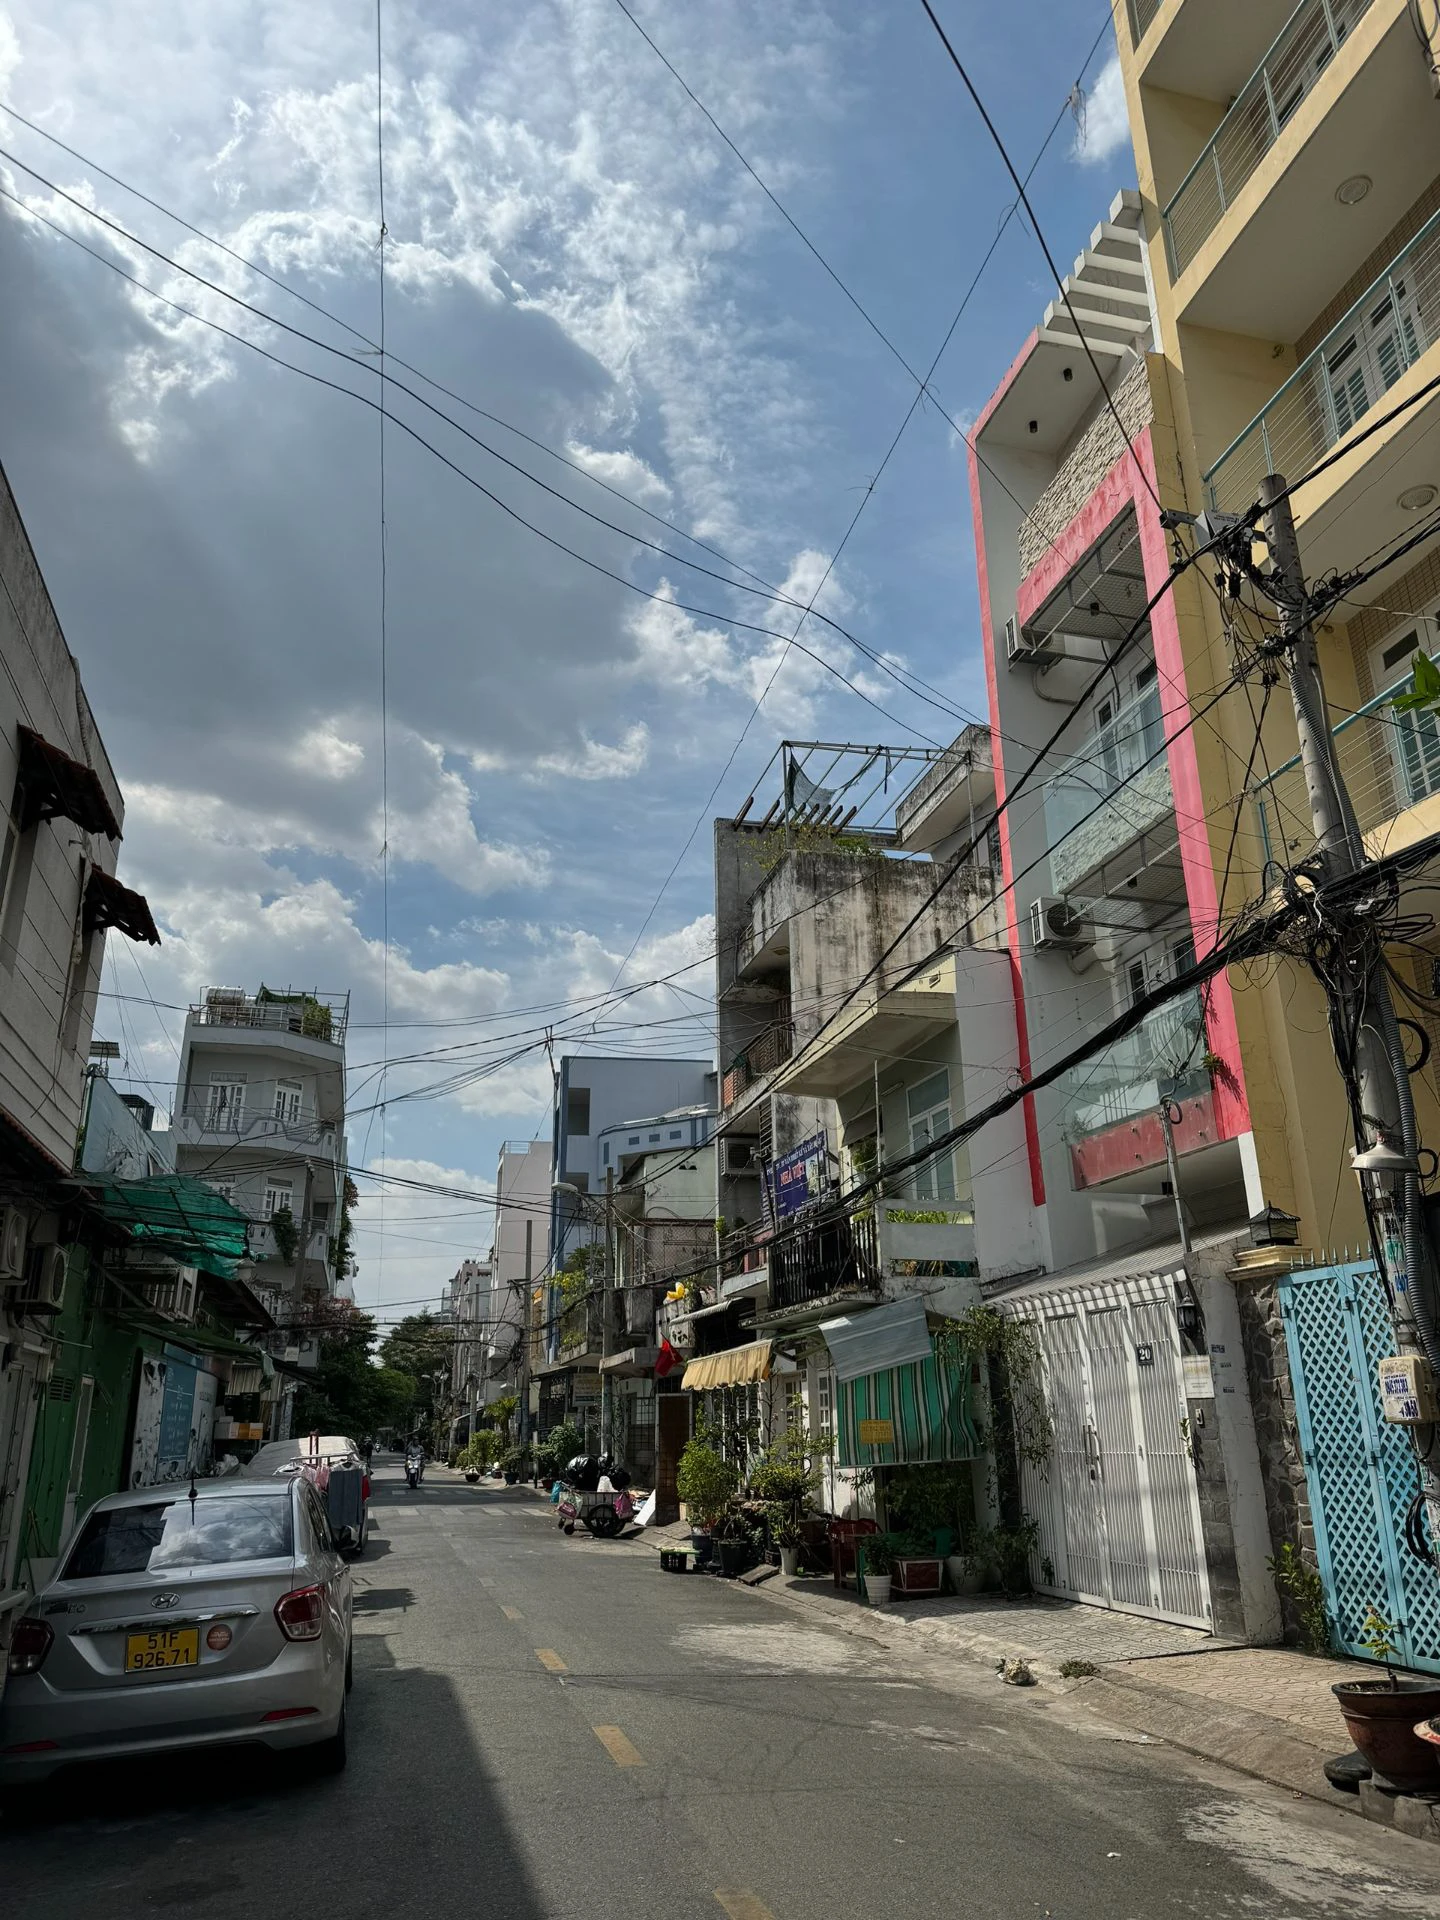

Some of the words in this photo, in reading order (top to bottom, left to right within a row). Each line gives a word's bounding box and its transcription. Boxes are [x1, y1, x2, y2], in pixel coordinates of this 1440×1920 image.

[1139, 1348, 1151, 1360] 20
[147, 1631, 180, 1649] 51F
[133, 1648, 191, 1669] 926.71
